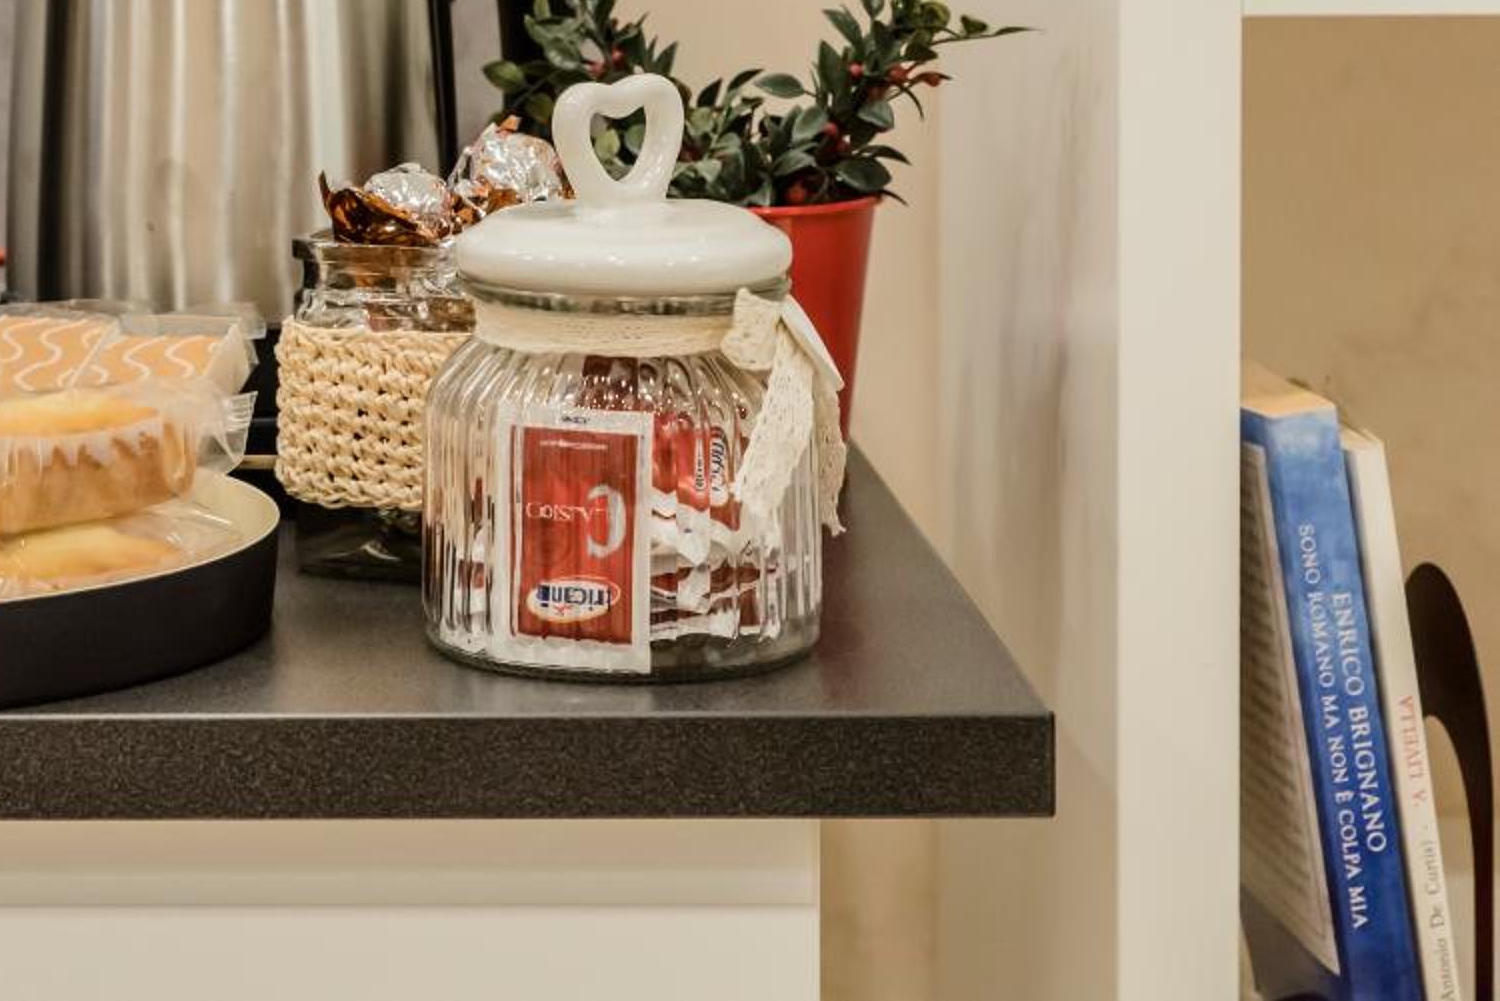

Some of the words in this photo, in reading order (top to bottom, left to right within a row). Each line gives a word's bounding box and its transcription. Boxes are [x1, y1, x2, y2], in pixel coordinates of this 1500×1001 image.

[1299, 524, 1321, 584] SONO
[1307, 592, 1336, 688] ROMANO
[1321, 695, 1340, 728] MA
[1333, 592, 1364, 696] ENRICO
[1349, 705, 1387, 852] BRIGNANO
[1399, 695, 1424, 778] LIVELLA
[1328, 735, 1348, 784] NON
[1339, 810, 1363, 879] COLPA
[1348, 886, 1368, 928] MIA
[1429, 907, 1445, 929] De
